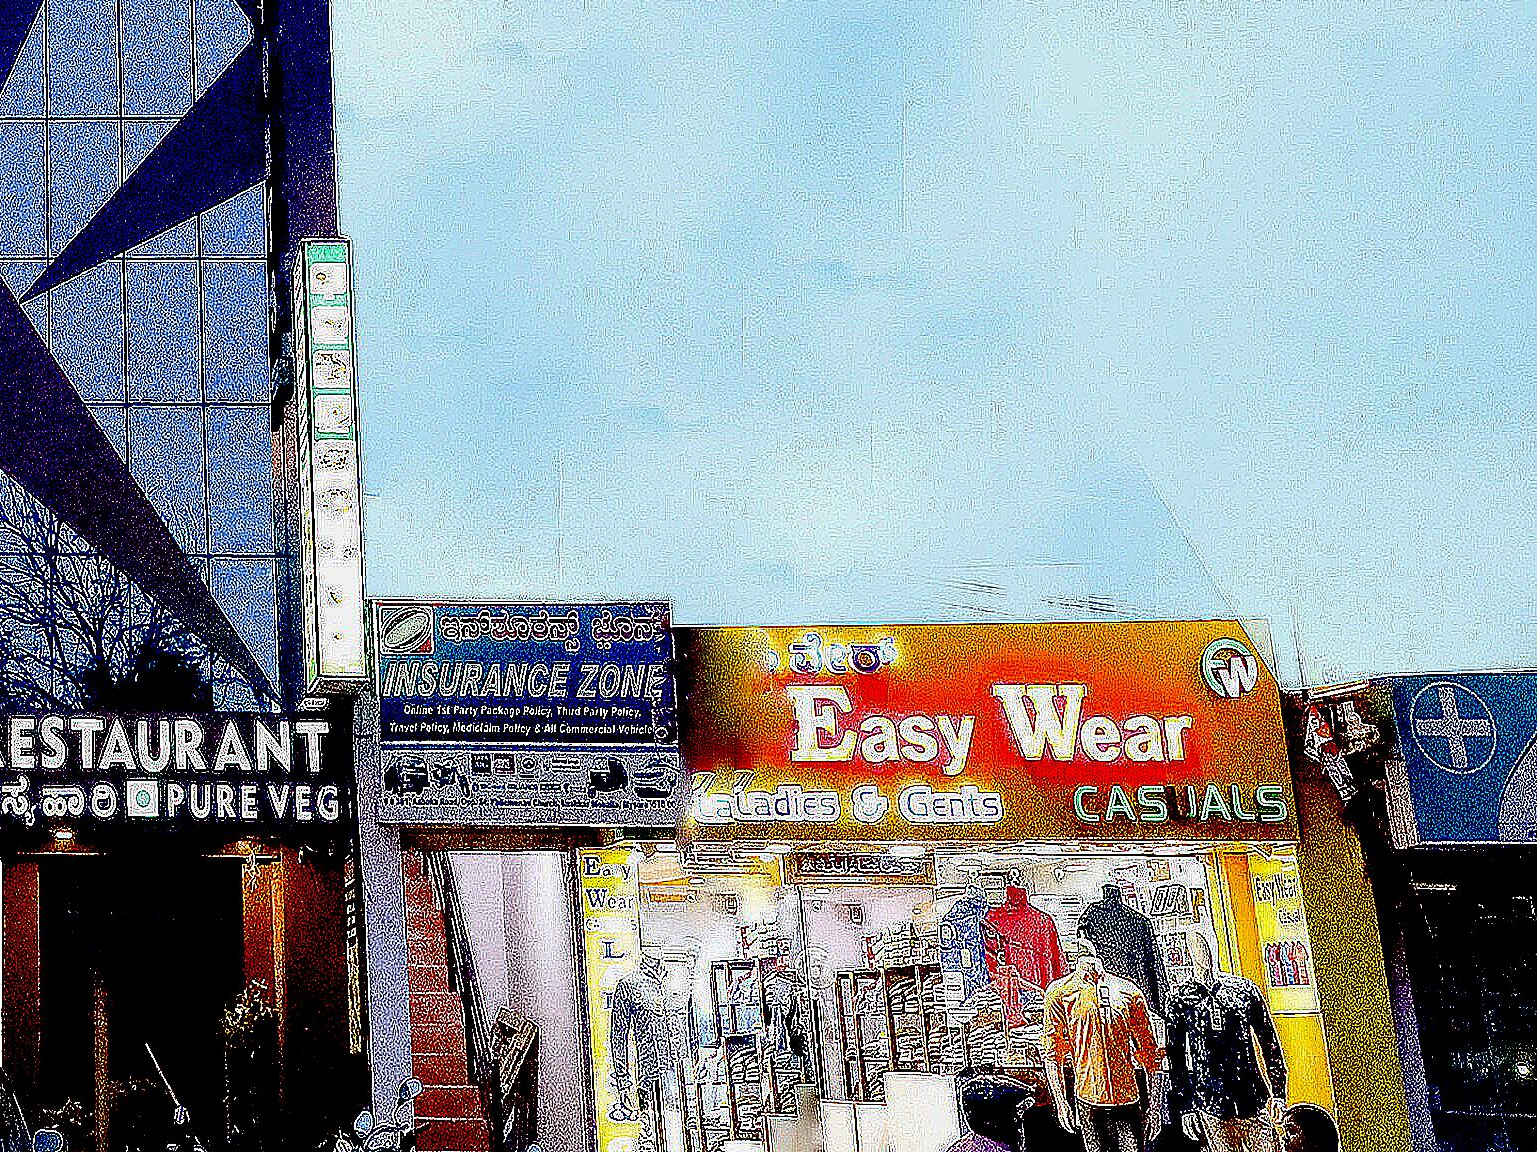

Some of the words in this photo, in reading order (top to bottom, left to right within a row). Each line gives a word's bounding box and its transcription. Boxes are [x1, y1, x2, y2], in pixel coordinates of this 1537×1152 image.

[381, 660, 571, 698] INSURANCE
[576, 662, 665, 700] ZONE
[453, 705, 478, 718] Party
[557, 706, 581, 717] Third
[787, 682, 977, 777] Easy
[991, 682, 1194, 764] Wear
[168, 782, 259, 820] PURE
[267, 784, 340, 822] VEG
[851, 785, 888, 824] &
[897, 783, 1005, 825] Gents
[1073, 785, 1291, 824] CASUALS
[583, 856, 632, 881] Eay
[585, 888, 634, 910] Wear
